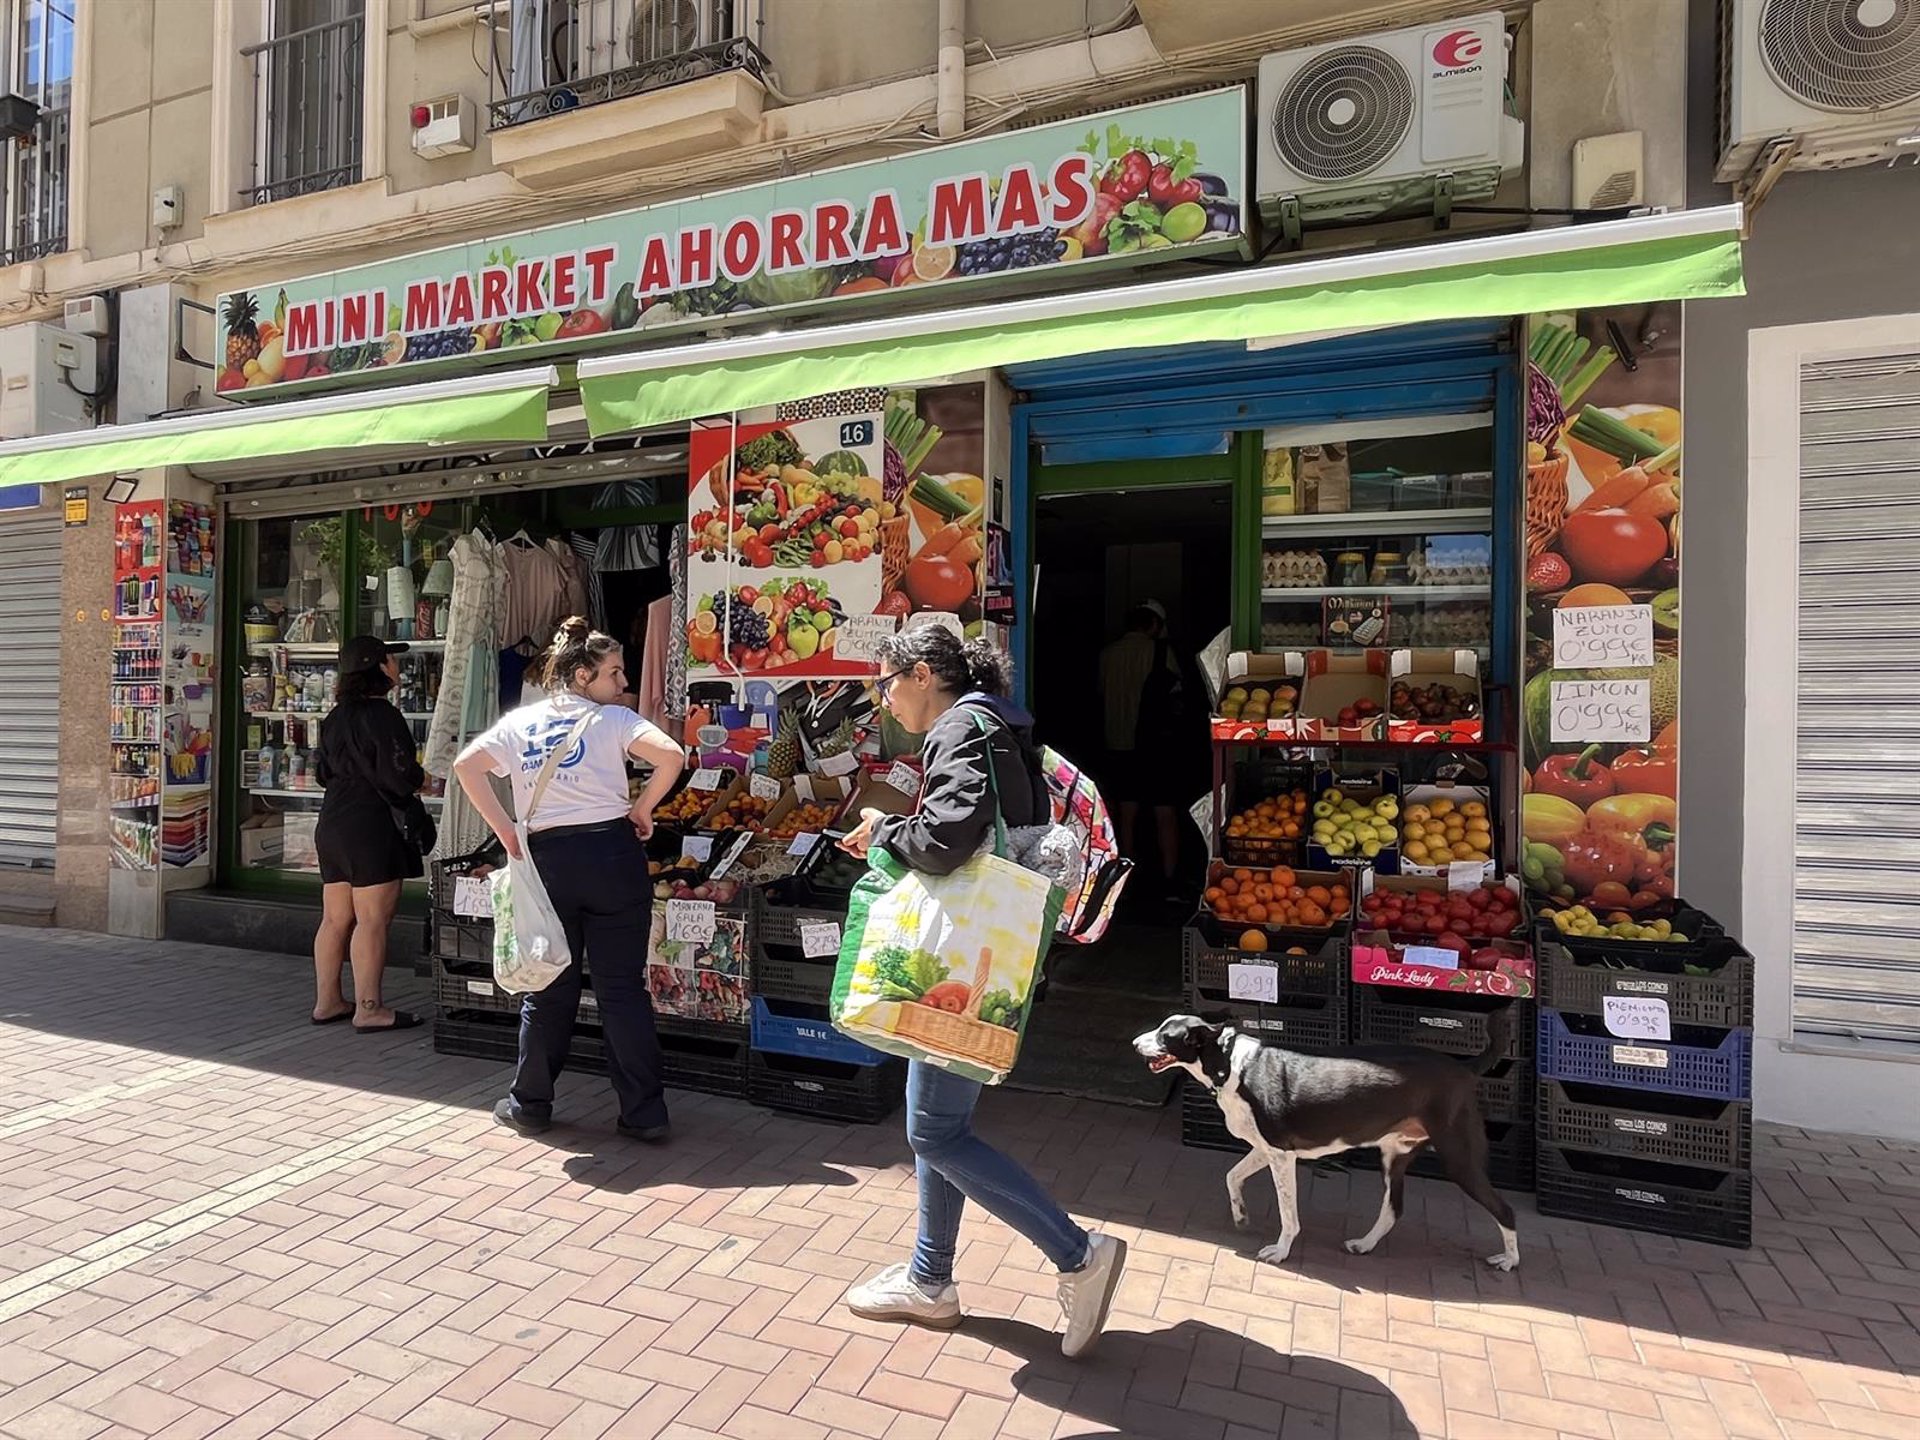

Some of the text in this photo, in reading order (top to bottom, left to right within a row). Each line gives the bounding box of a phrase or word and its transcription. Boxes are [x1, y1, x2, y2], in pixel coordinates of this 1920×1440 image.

[1432, 65, 1482, 79] almison
[285, 157, 1093, 354] MINI MARKET AHORRA MAS
[842, 424, 864, 444] 16
[1560, 608, 1650, 627] NARANJA
[1573, 624, 1637, 637] ZUMO
[1555, 682, 1639, 701] LIMON
[1371, 966, 1437, 987] Pink Lady
